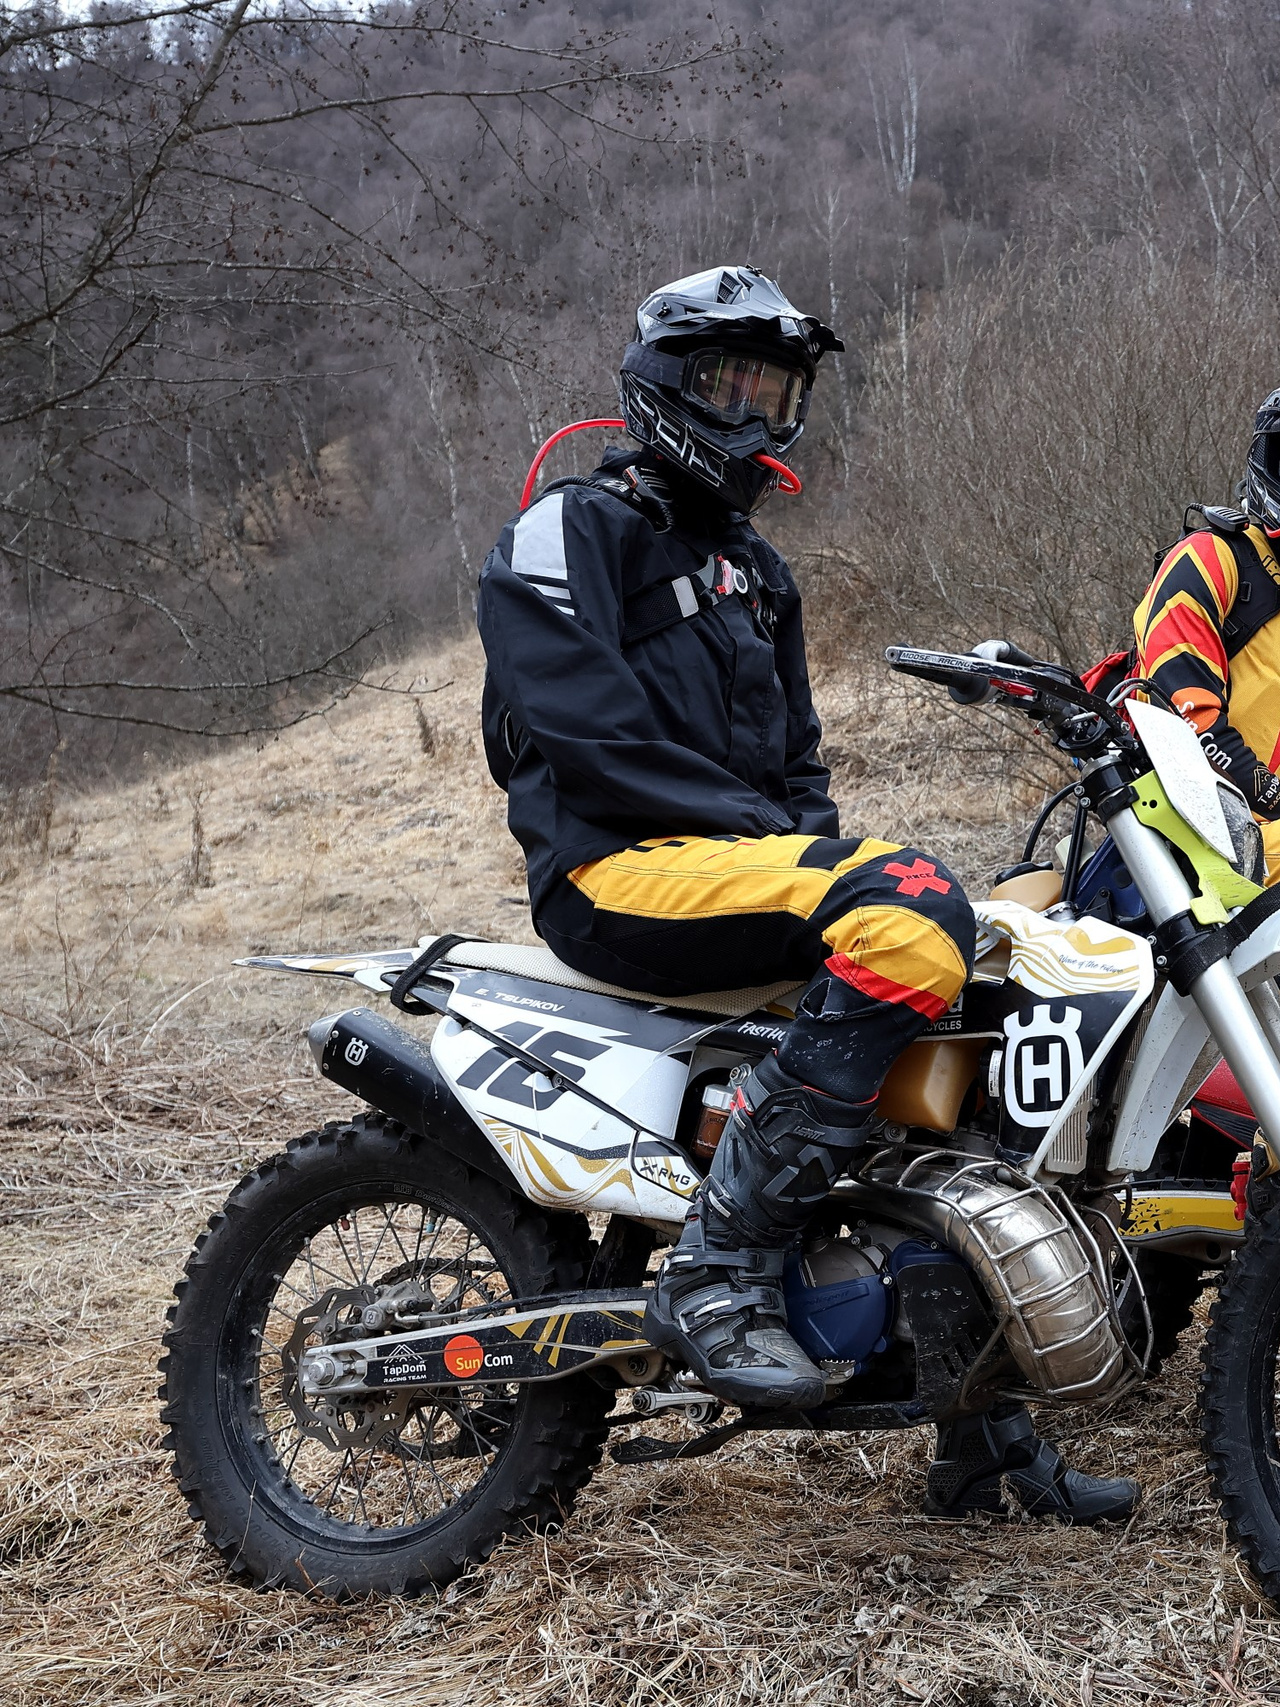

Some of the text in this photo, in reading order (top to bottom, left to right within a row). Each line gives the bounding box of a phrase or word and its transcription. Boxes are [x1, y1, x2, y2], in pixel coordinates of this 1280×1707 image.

[900, 651, 972, 669] MOOSE RACING
[1198, 732, 1233, 770] Com
[494, 991, 566, 1012] TSUPIKOV
[658, 1167, 691, 1186] RMG
[382, 1362, 427, 1376] TapDom
[456, 1354, 513, 1371] Sun Com
